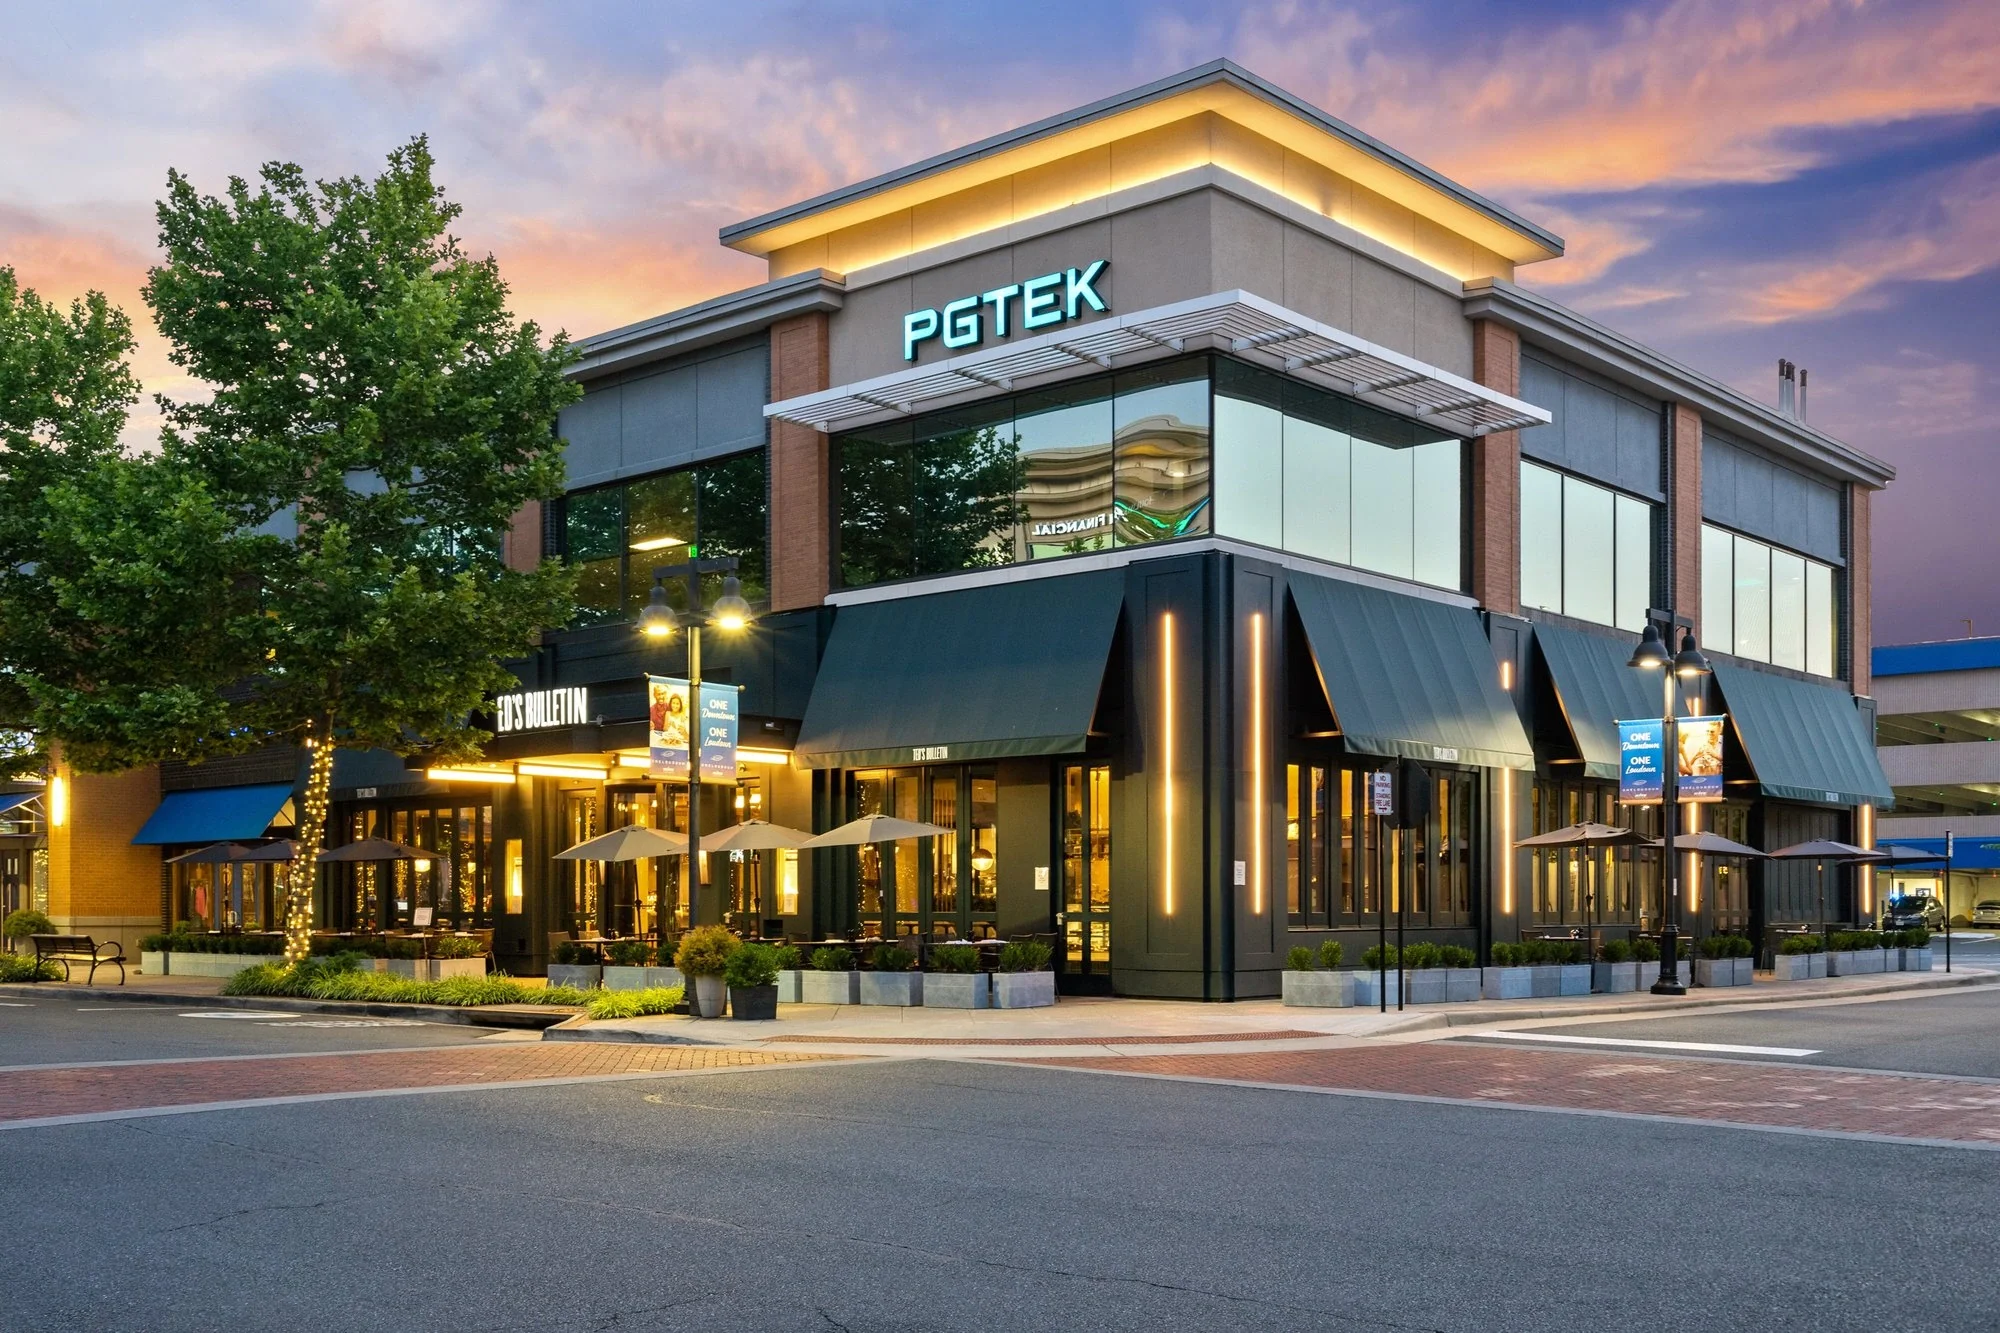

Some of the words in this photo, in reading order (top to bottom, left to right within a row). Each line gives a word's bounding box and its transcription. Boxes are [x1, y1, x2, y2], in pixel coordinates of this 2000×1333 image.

[904, 259, 1110, 361] PGTEK
[497, 693, 523, 732] ED'S
[525, 687, 587, 729] BULLETIN
[709, 699, 728, 710] ONE
[709, 727, 728, 737] ONE
[1630, 733, 1651, 741] ONE
[1622, 741, 1660, 751] Downtown
[1630, 756, 1651, 765] ONE
[1625, 765, 1656, 775] Loudoun
